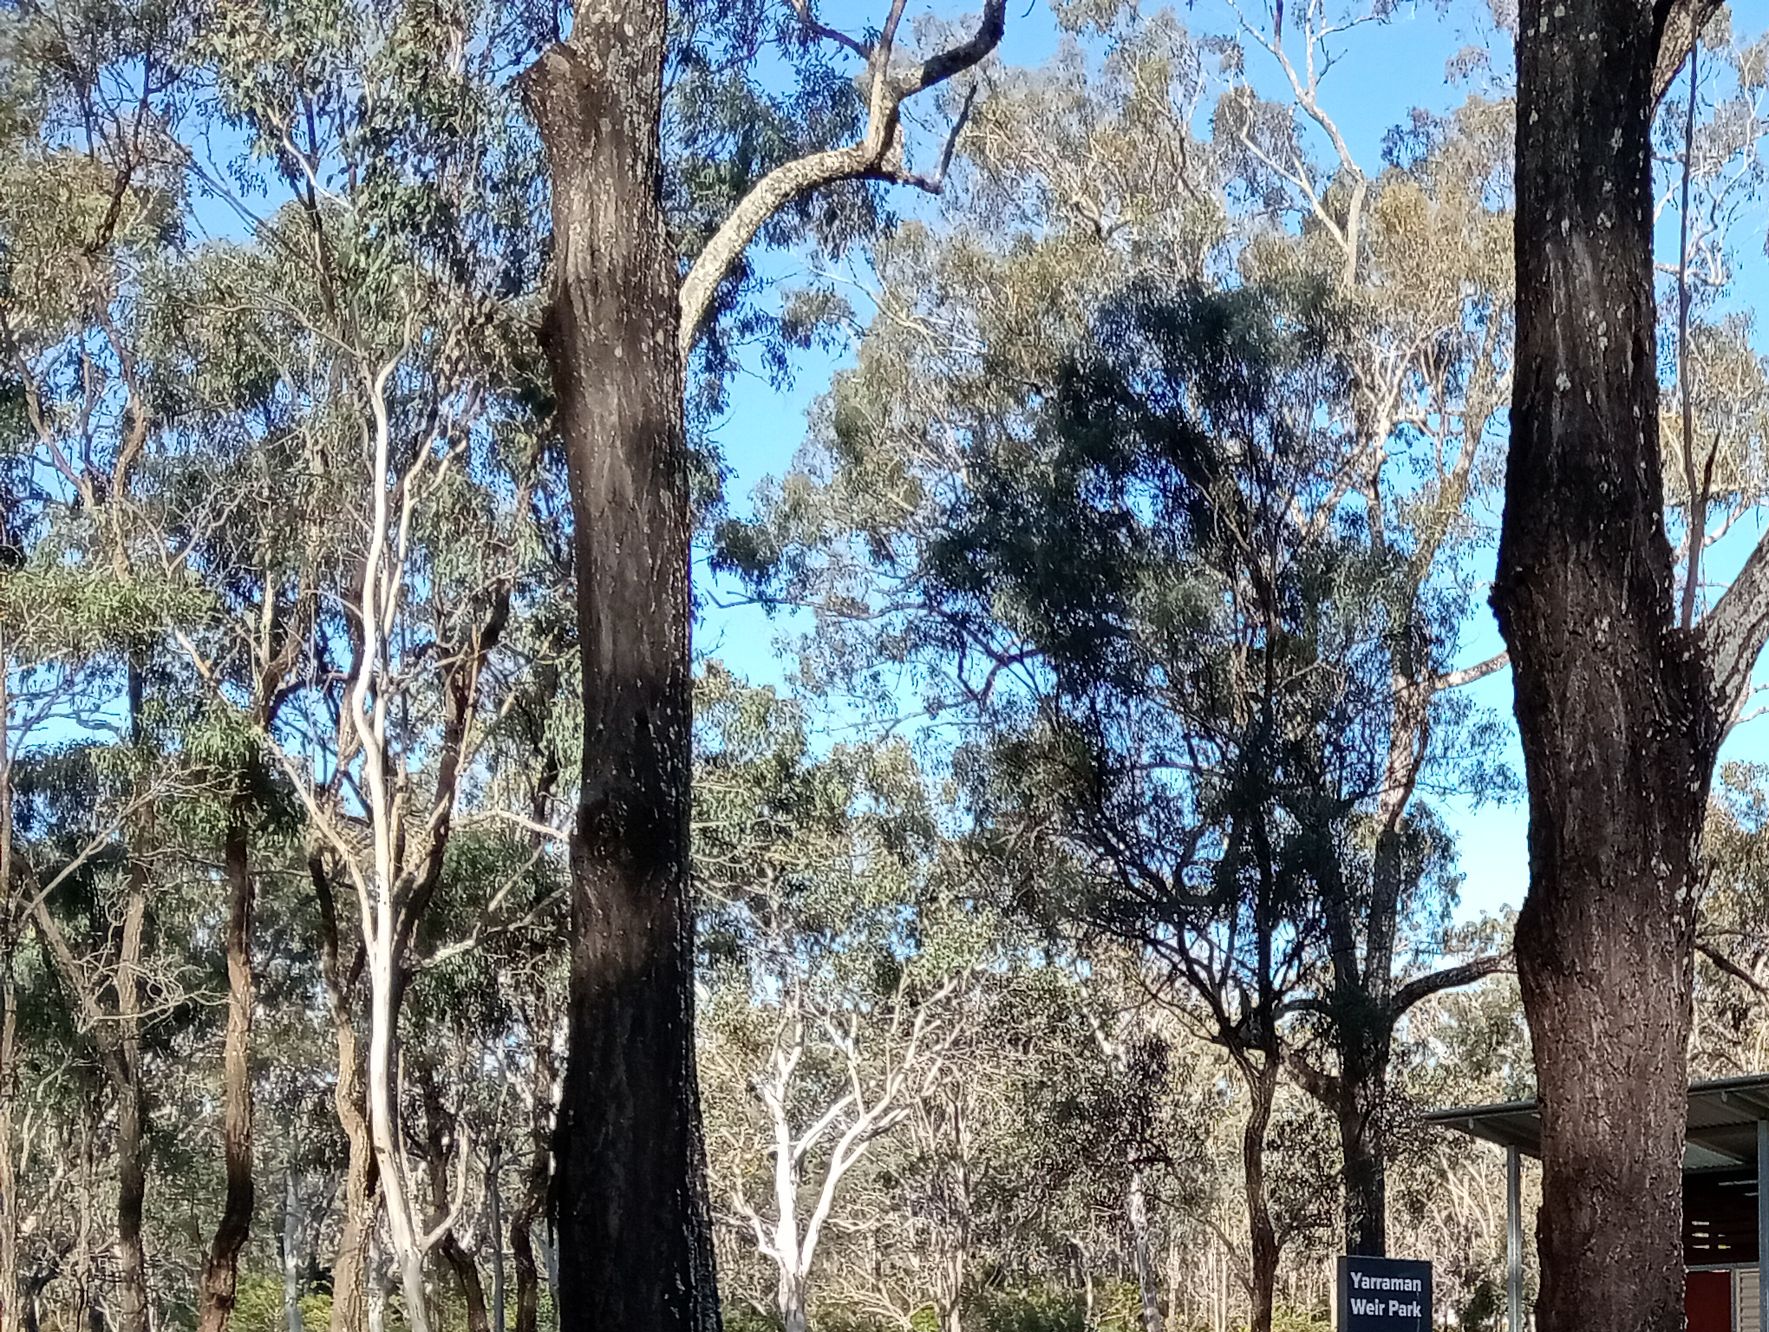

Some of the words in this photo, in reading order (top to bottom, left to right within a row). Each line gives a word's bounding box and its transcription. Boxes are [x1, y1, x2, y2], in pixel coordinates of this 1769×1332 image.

[1350, 1271, 1422, 1292] Yarraman
[1350, 1297, 1386, 1316] Weir
[1388, 1299, 1422, 1318] Park
